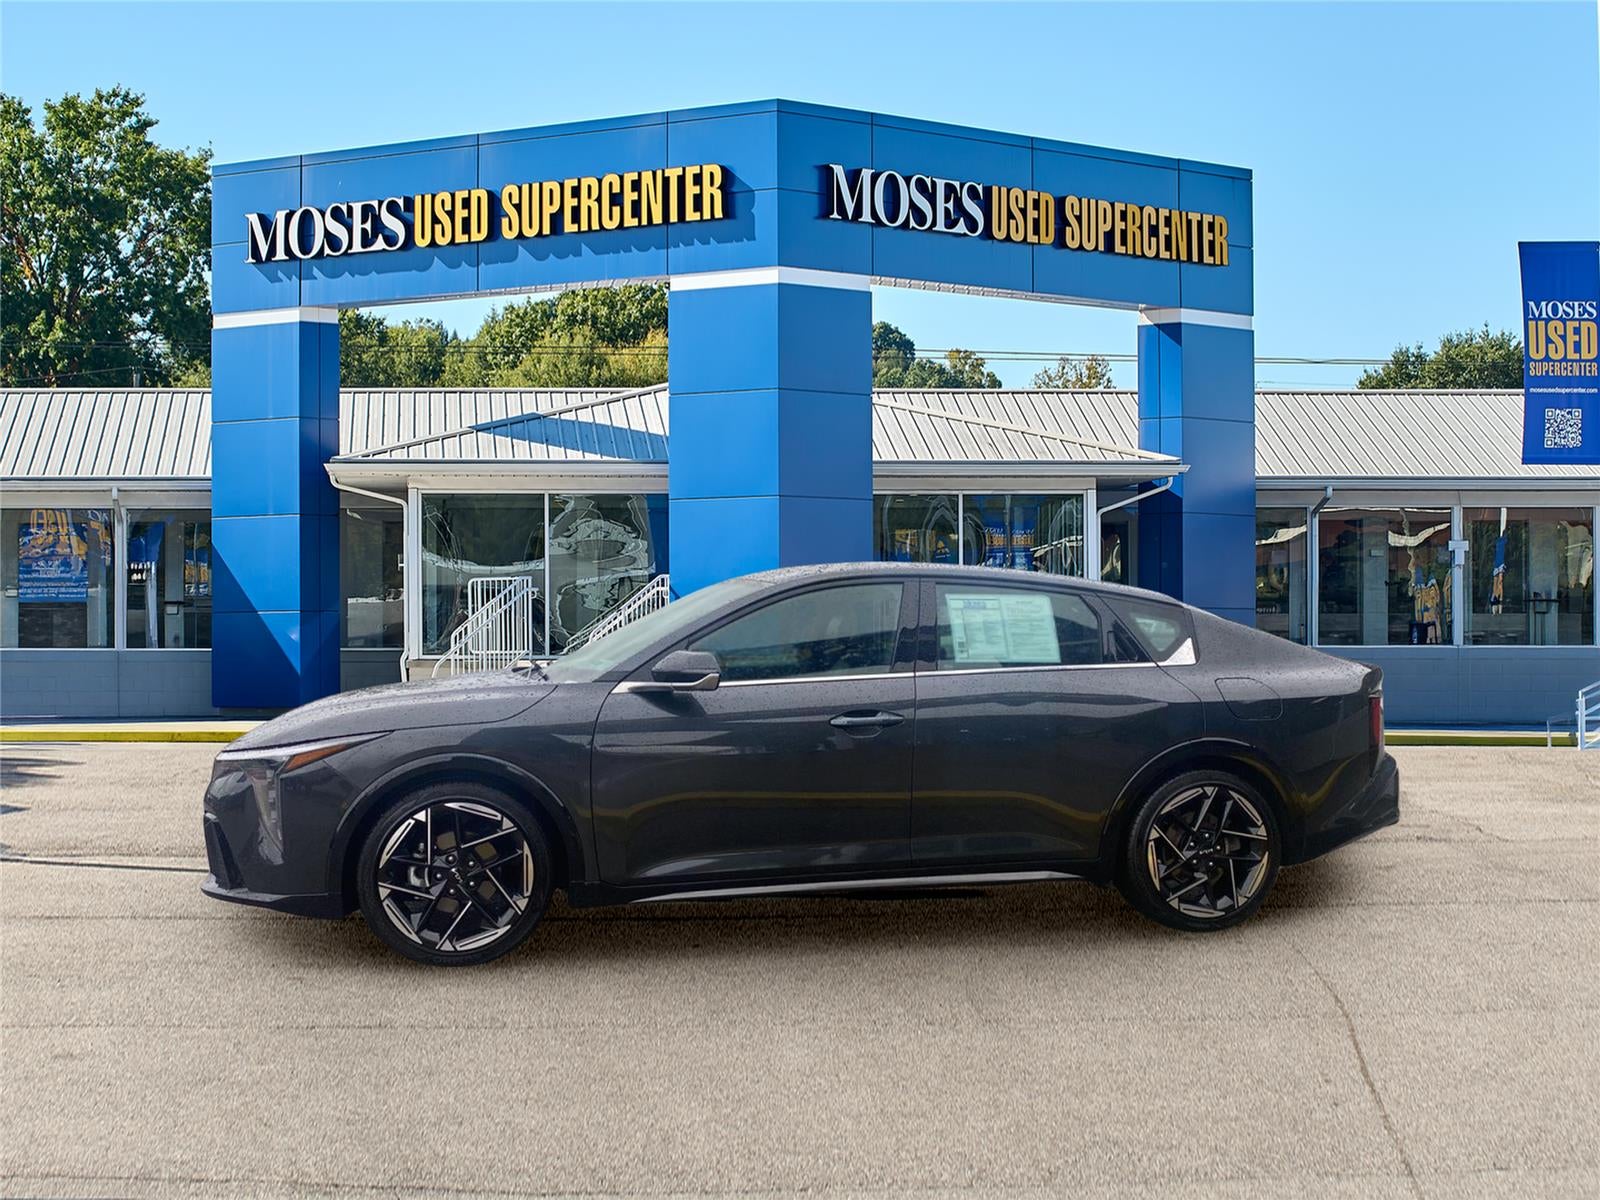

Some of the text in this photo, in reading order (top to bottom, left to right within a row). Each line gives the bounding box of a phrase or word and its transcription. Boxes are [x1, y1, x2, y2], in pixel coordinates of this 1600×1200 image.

[244, 165, 724, 264] MOSES USED SUPERCENTER
[829, 164, 1229, 266] MOSES USED SUPERCENTER
[1528, 301, 1597, 319] MOSES
[1528, 321, 1598, 360] USED
[1529, 362, 1598, 376] SUPERCENTER
